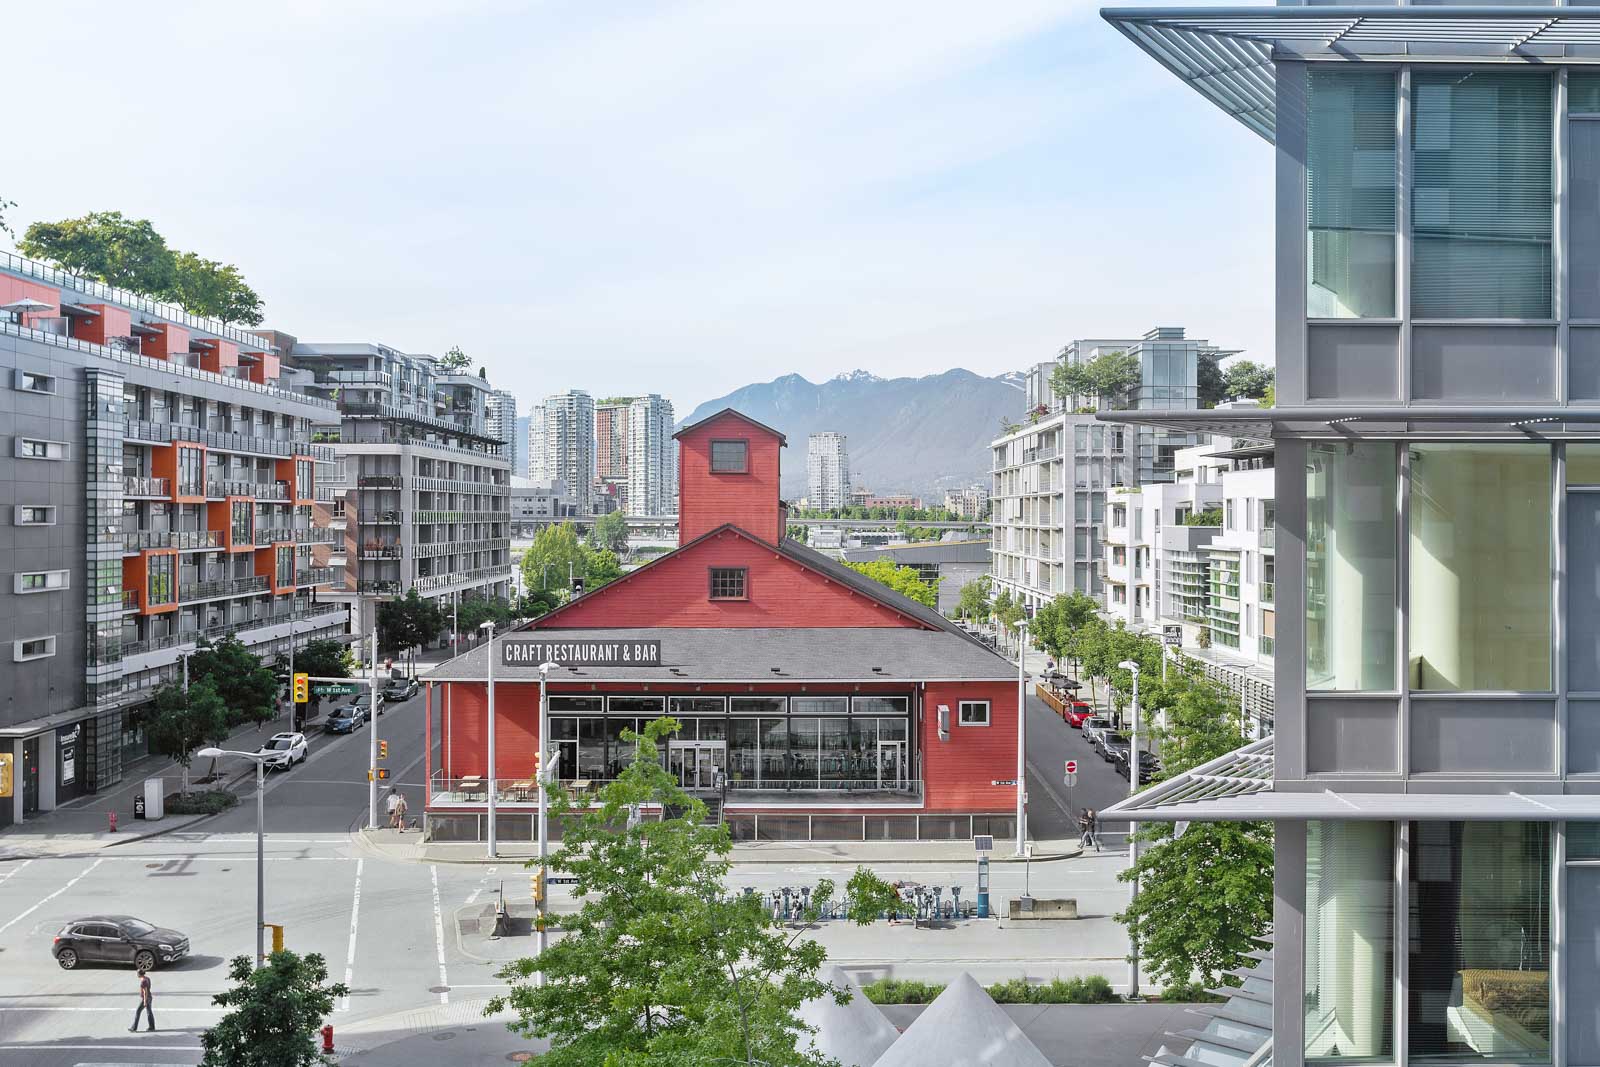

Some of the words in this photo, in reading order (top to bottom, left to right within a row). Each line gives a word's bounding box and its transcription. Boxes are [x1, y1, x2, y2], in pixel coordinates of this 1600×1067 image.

[506, 644, 542, 661] CRAFT
[546, 644, 619, 661] RESTAURANT
[622, 644, 631, 661] &
[634, 644, 657, 661] BAR
